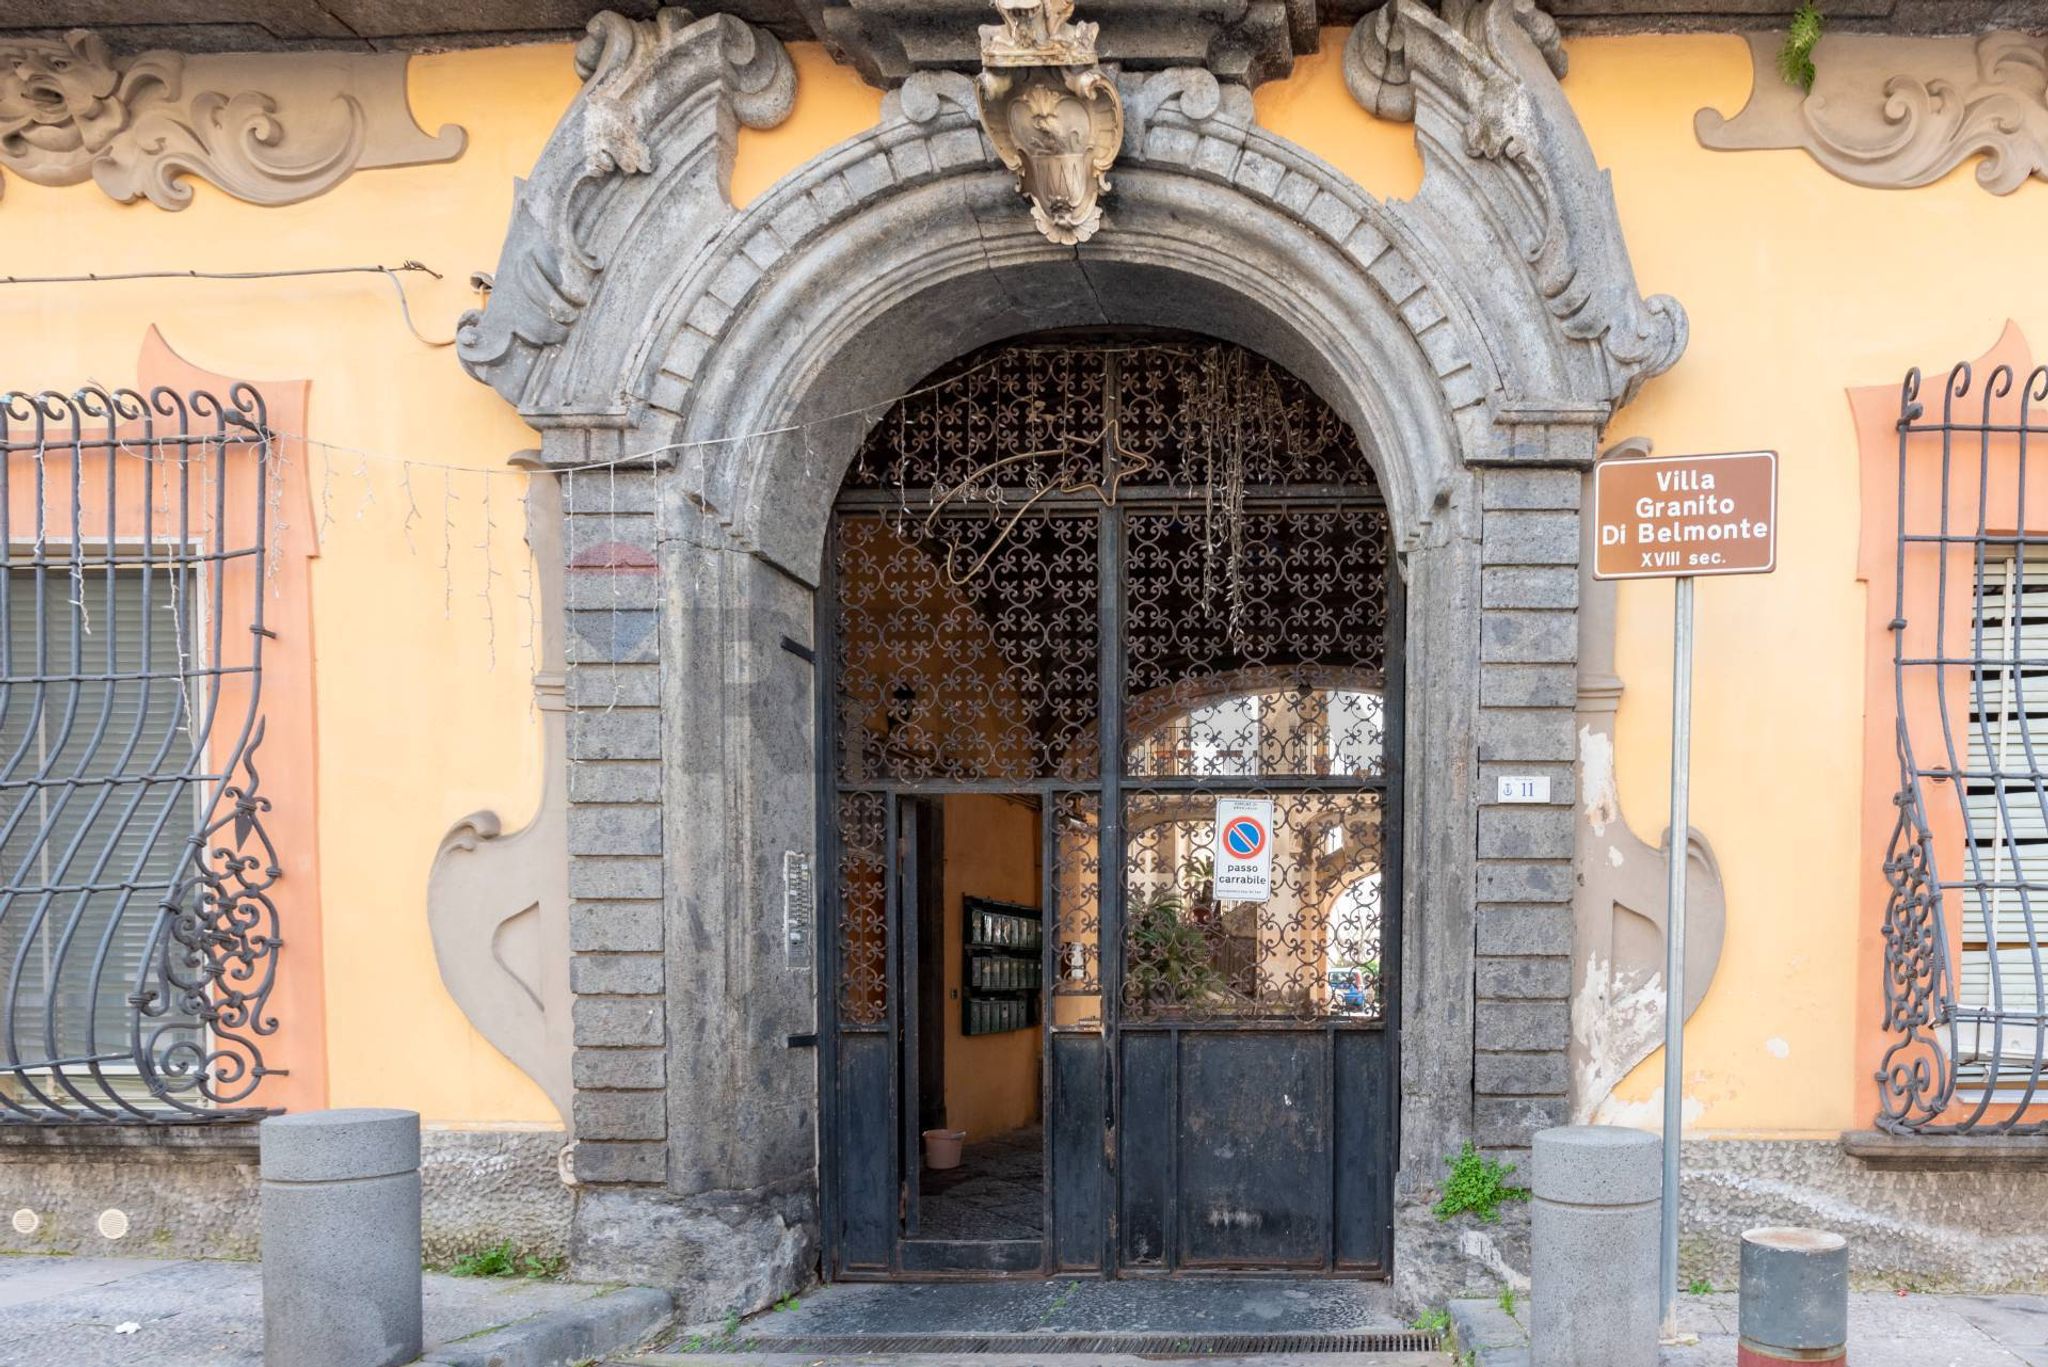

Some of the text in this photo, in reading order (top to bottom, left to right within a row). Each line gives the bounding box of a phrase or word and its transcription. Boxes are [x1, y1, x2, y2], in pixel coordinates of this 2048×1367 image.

[1656, 469, 1715, 492] Villa
[1635, 494, 1735, 518] Granito
[1602, 518, 1768, 545] Di Belmonte
[1640, 551, 1726, 568] XVIII sec.
[1521, 782, 1534, 797] 11
[1227, 864, 1258, 873] passo
[1218, 875, 1267, 885] carrabile
